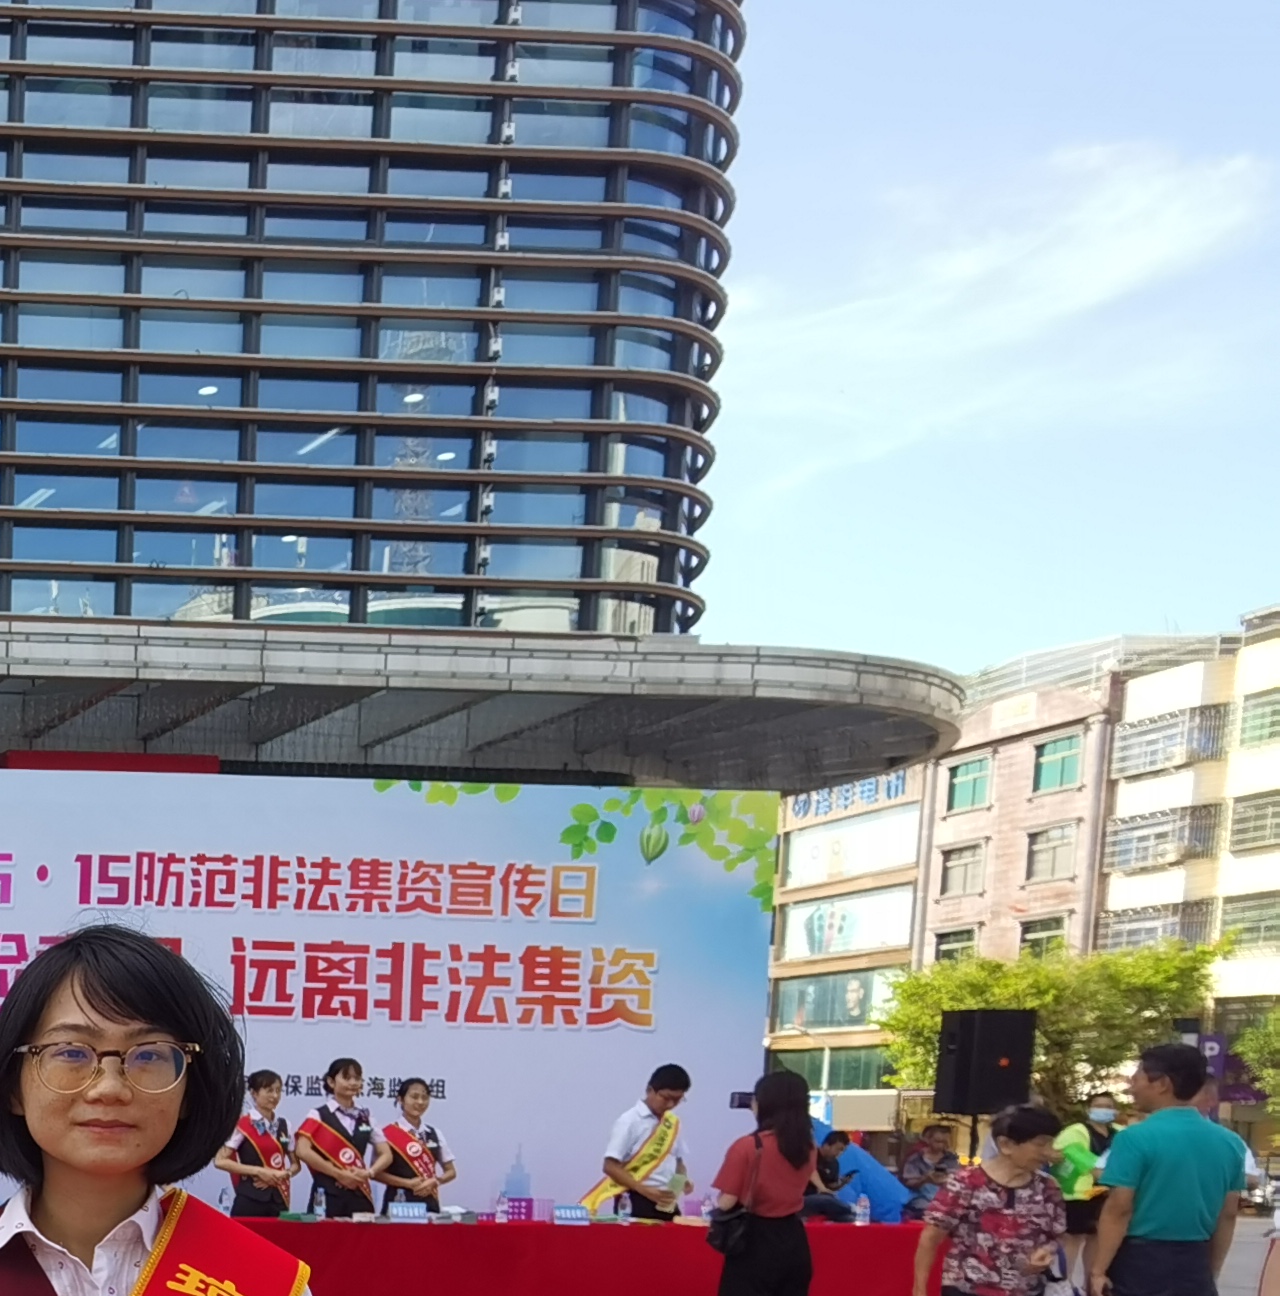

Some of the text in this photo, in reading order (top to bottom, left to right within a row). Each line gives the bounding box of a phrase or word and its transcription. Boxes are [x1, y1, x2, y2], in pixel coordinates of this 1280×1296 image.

[230, 936, 656, 1029] 远离非法集资
